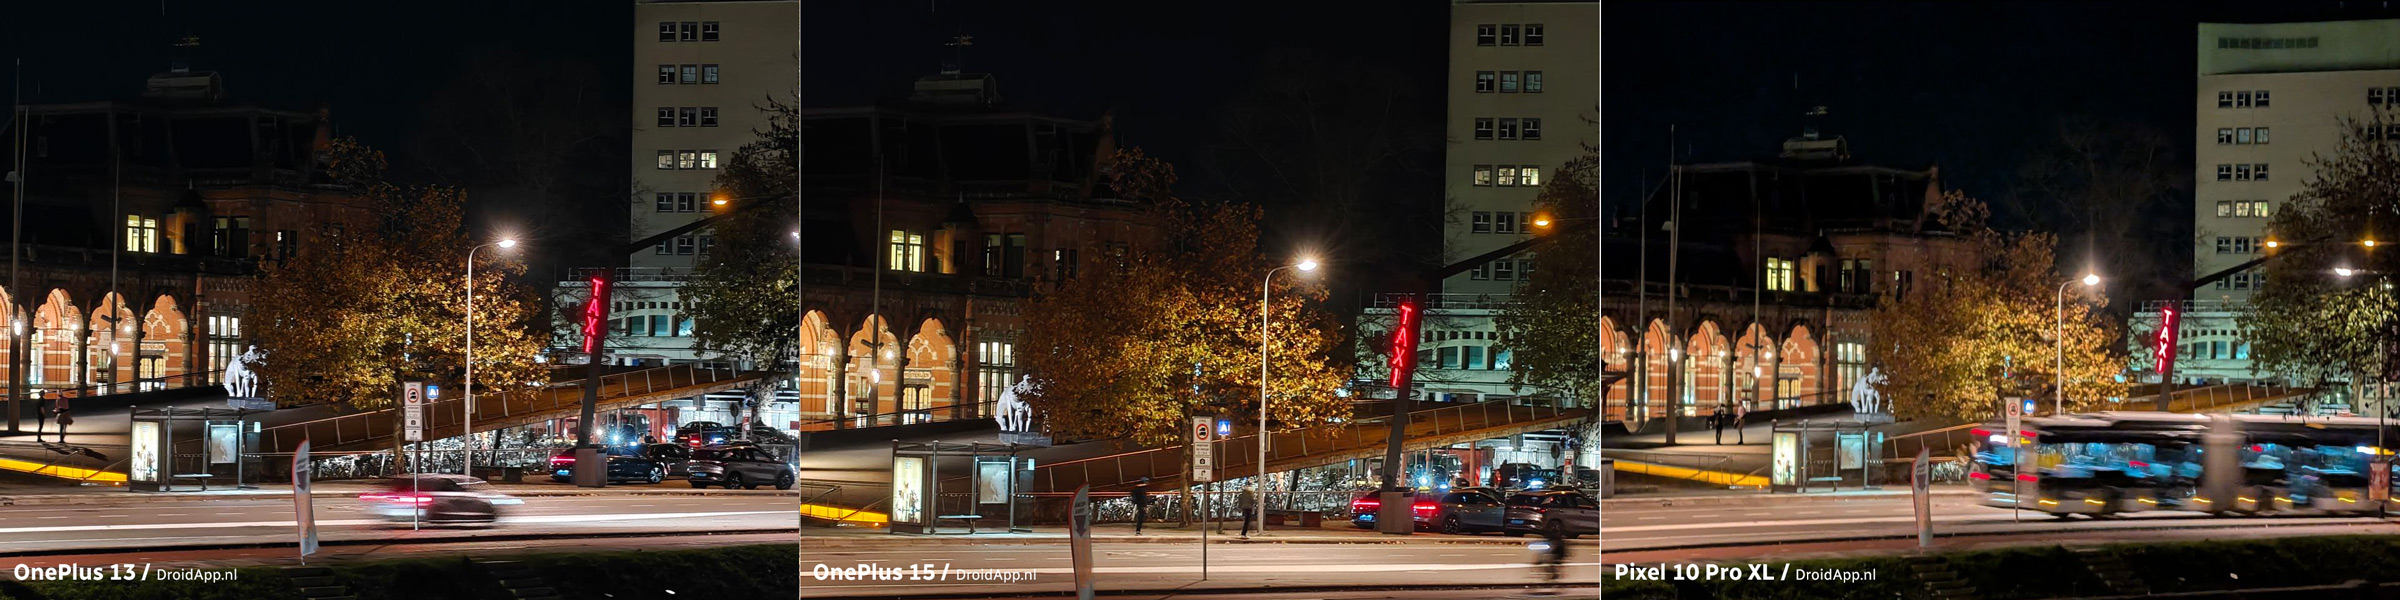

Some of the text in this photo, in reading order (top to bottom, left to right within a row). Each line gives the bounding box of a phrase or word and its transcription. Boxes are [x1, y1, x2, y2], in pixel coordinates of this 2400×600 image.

[585, 278, 604, 354] TAXI
[1391, 304, 1412, 386] TAXI
[2158, 309, 2172, 372] TAXI
